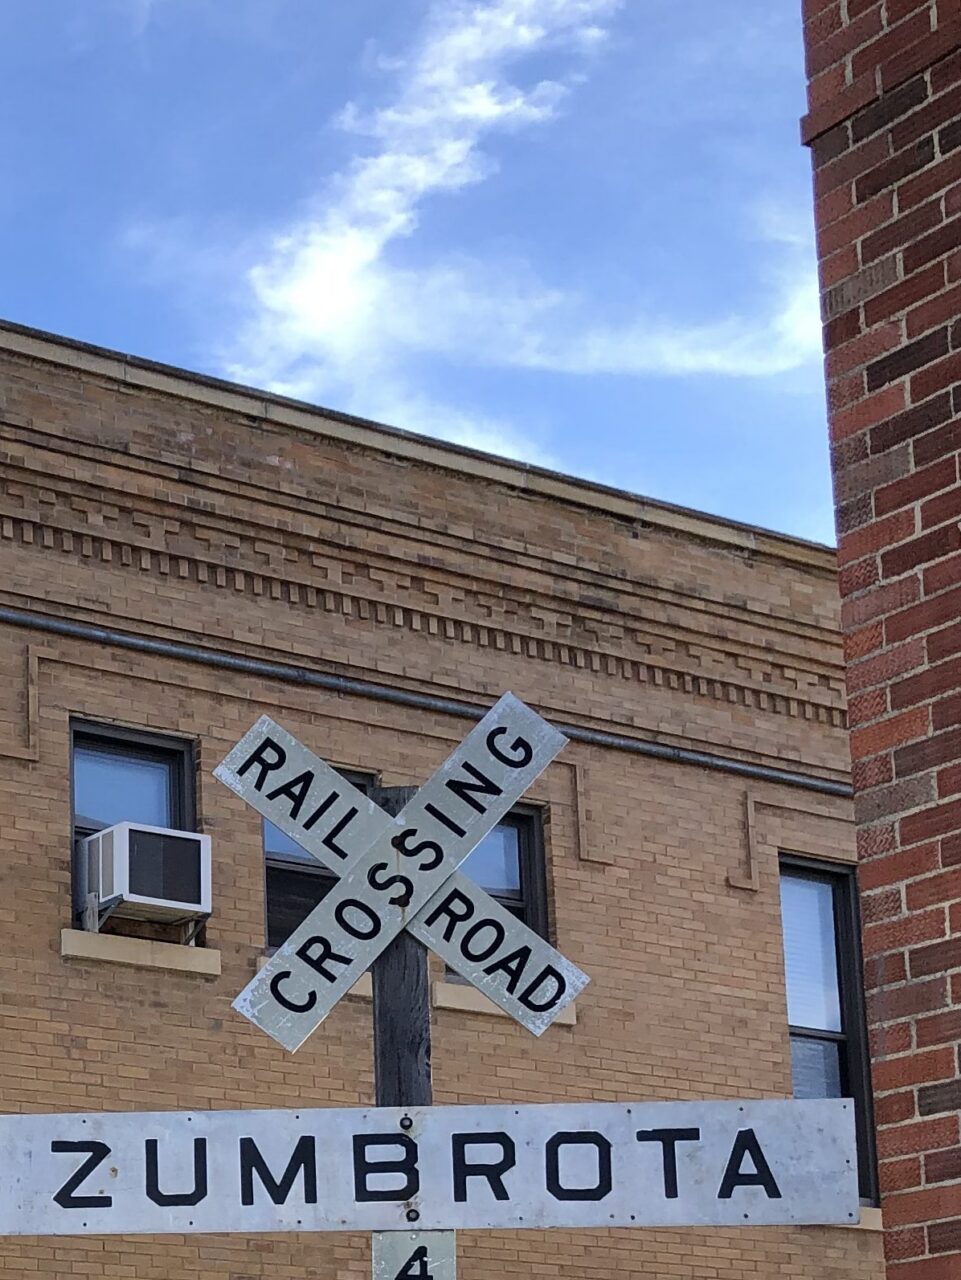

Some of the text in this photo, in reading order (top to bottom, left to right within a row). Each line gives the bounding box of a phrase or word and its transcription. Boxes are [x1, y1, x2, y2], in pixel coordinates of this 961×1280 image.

[235, 736, 568, 1013] RAIL ROAD
[270, 726, 533, 1013] CROSSING
[50, 1127, 783, 1208] ZUMBROTA
